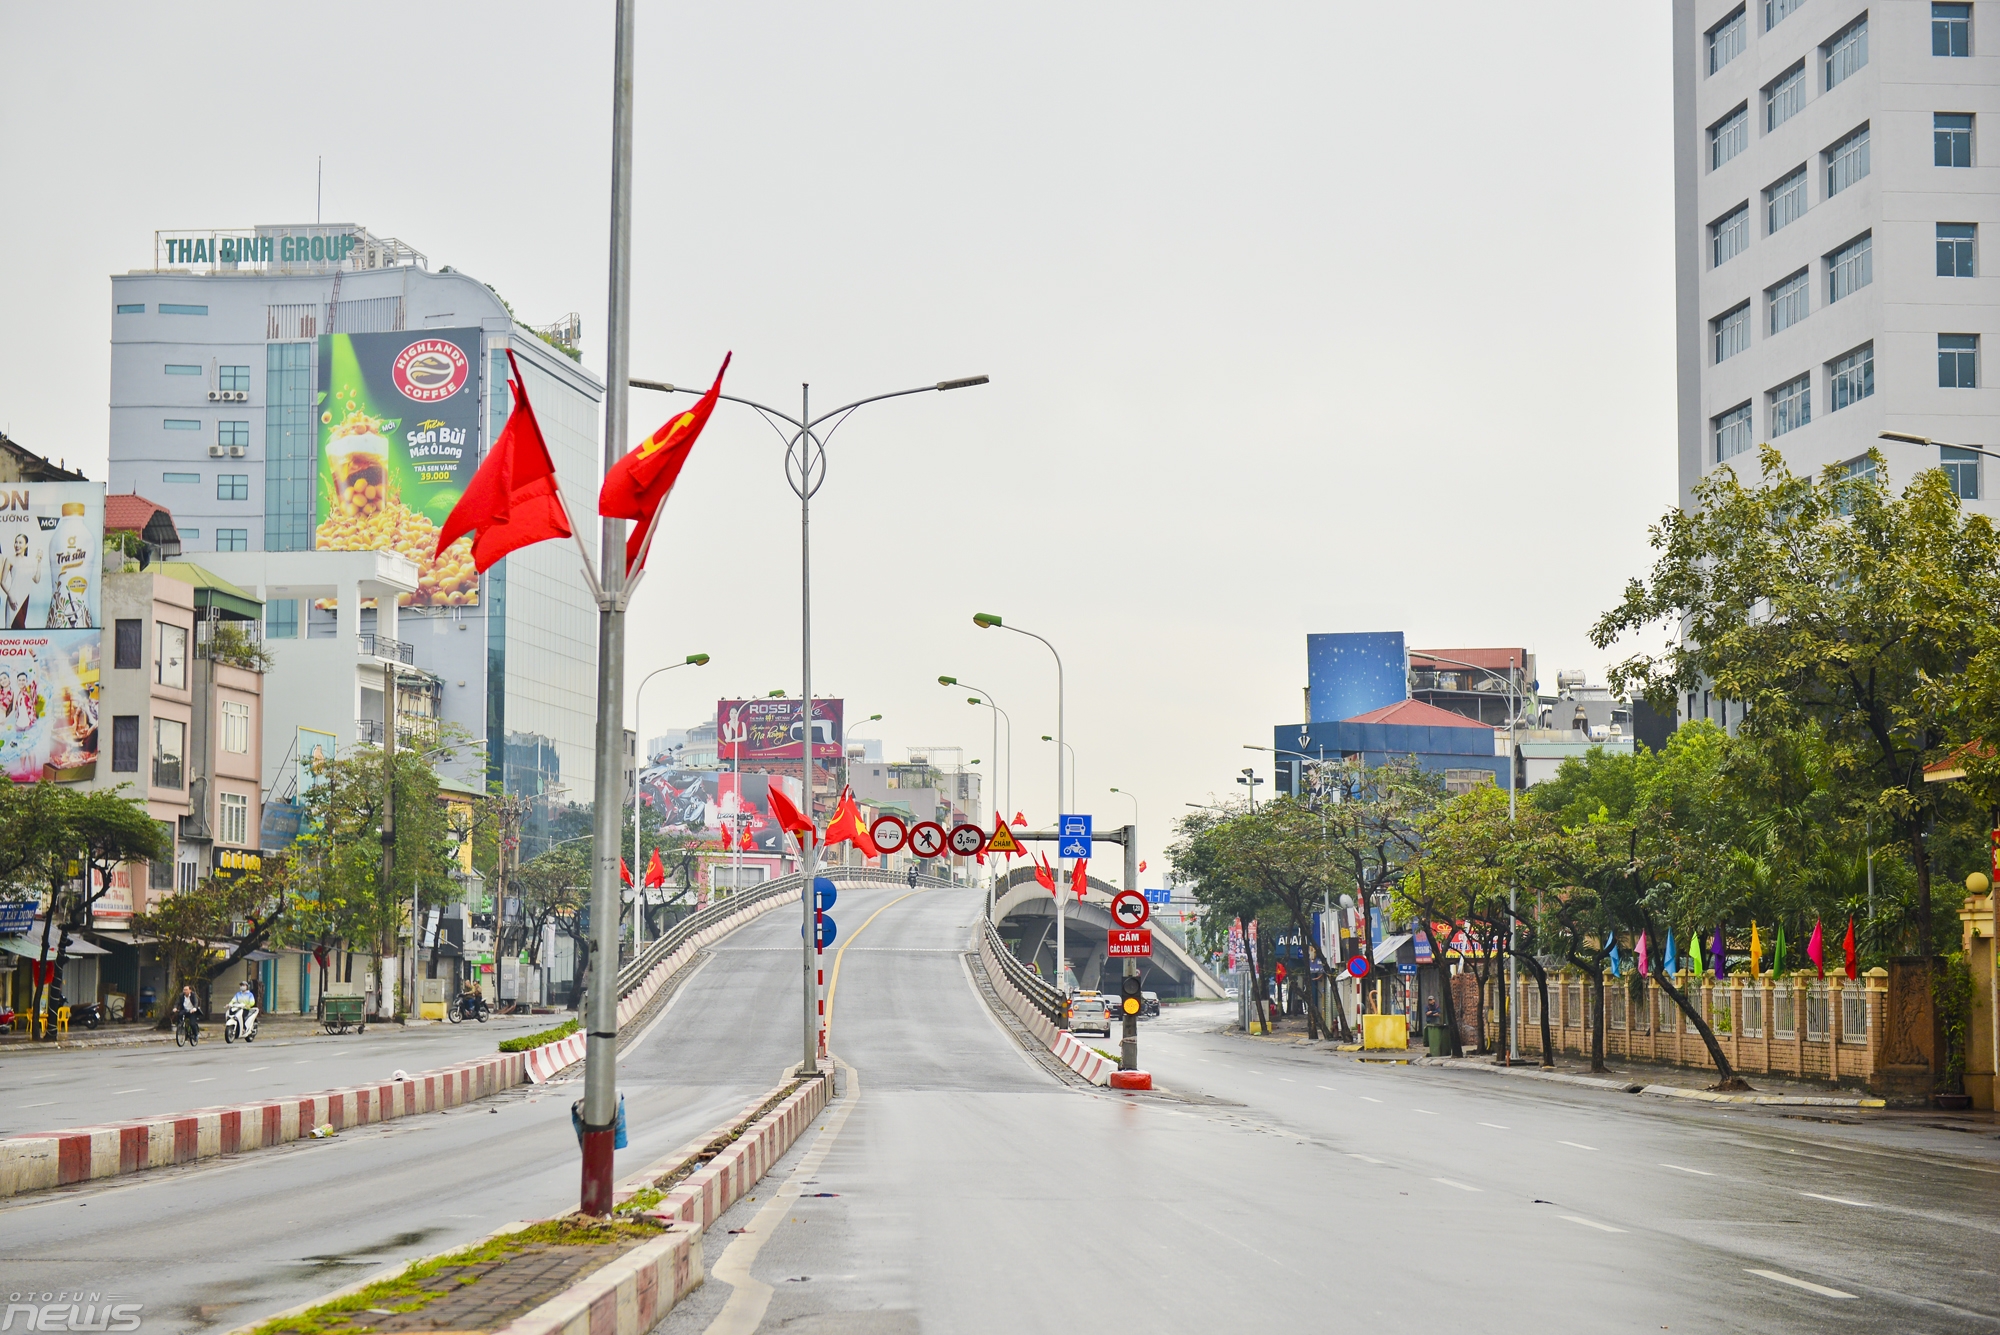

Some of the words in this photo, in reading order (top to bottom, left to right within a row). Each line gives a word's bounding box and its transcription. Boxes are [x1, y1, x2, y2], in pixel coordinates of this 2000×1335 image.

[166, 239, 214, 263] THAI
[221, 238, 274, 262] BINH
[281, 235, 354, 262] GROUP
[397, 343, 464, 369] HIGHLANDS
[404, 382, 457, 399] COFFEE
[382, 421, 396, 432] MỚI
[406, 430, 437, 447] Sen
[439, 427, 466, 445] Bùi
[410, 445, 429, 458] Mát
[430, 442, 438, 455] Ô
[439, 444, 462, 459] Long
[440, 463, 457, 471] VÀNG
[420, 471, 449, 481] 39.000
[41, 517, 57, 527] MỚI
[749, 704, 791, 714] ROSSI
[957, 833, 977, 846] 3,5m
[1118, 930, 1140, 942] CẤM
[1110, 943, 1120, 953] CÁC
[1121, 945, 1133, 955] LOẠI
[1134, 945, 1141, 953] XE
